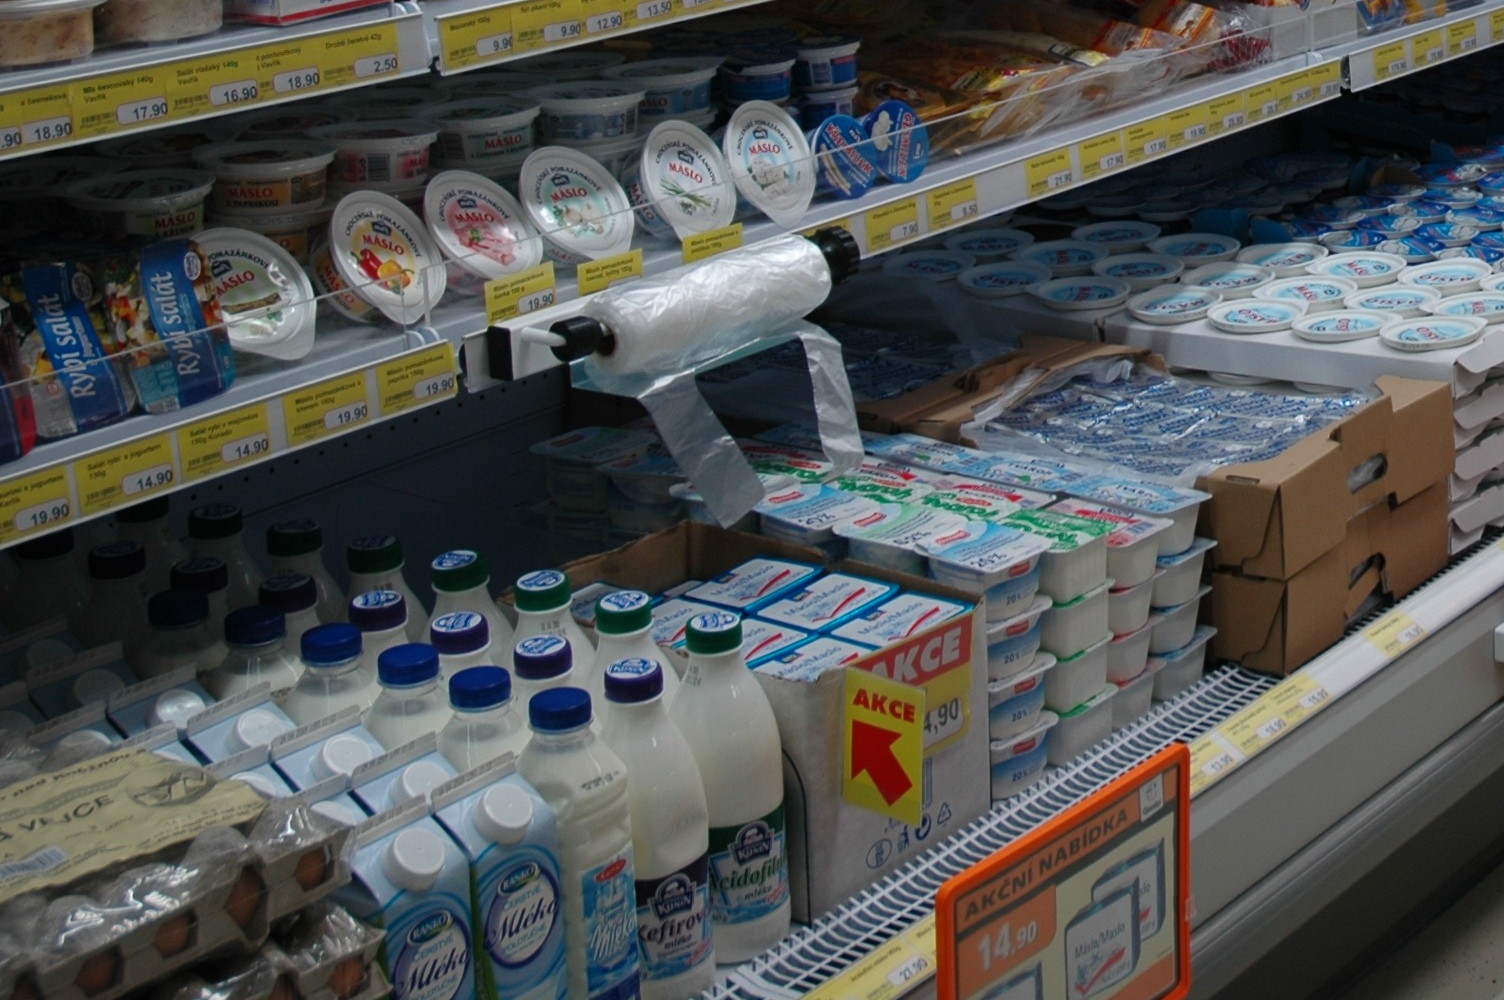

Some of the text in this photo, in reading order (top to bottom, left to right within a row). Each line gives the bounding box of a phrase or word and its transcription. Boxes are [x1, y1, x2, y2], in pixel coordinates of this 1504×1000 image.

[646, 2, 673, 17] 13.50
[560, 24, 581, 38] 9.90
[596, 16, 623, 30] 12.90
[373, 57, 397, 72] 2.50
[288, 72, 320, 89] 18.90
[223, 85, 258, 104] 16.90
[132, 102, 169, 122] 17.90
[34, 122, 73, 142] 18.90
[484, 135, 523, 150] MÁSLO
[748, 141, 781, 156] MÁSLO
[668, 162, 705, 185] MÁSLO
[227, 187, 274, 199] MÁSLO
[550, 187, 589, 203] MÁSLO
[155, 211, 196, 229] MÁSLO
[453, 210, 494, 225] MÁSLO
[362, 233, 406, 256] MÁSLO
[527, 292, 555, 311] 19.90
[150, 269, 201, 376] Rybí salát
[38, 291, 97, 399] Rybí salát
[425, 377, 455, 396] 19.90
[337, 404, 368, 425] 19.90
[234, 438, 269, 458] 14.90
[136, 470, 173, 491] 14.90
[30, 504, 70, 527] 19.90
[872, 627, 962, 682] AKCE
[852, 687, 916, 724] AKCE
[964, 807, 1128, 921] AKČNÍ NABÍDKA
[486, 897, 559, 948] Mléko
[979, 919, 1038, 971] 14,90
